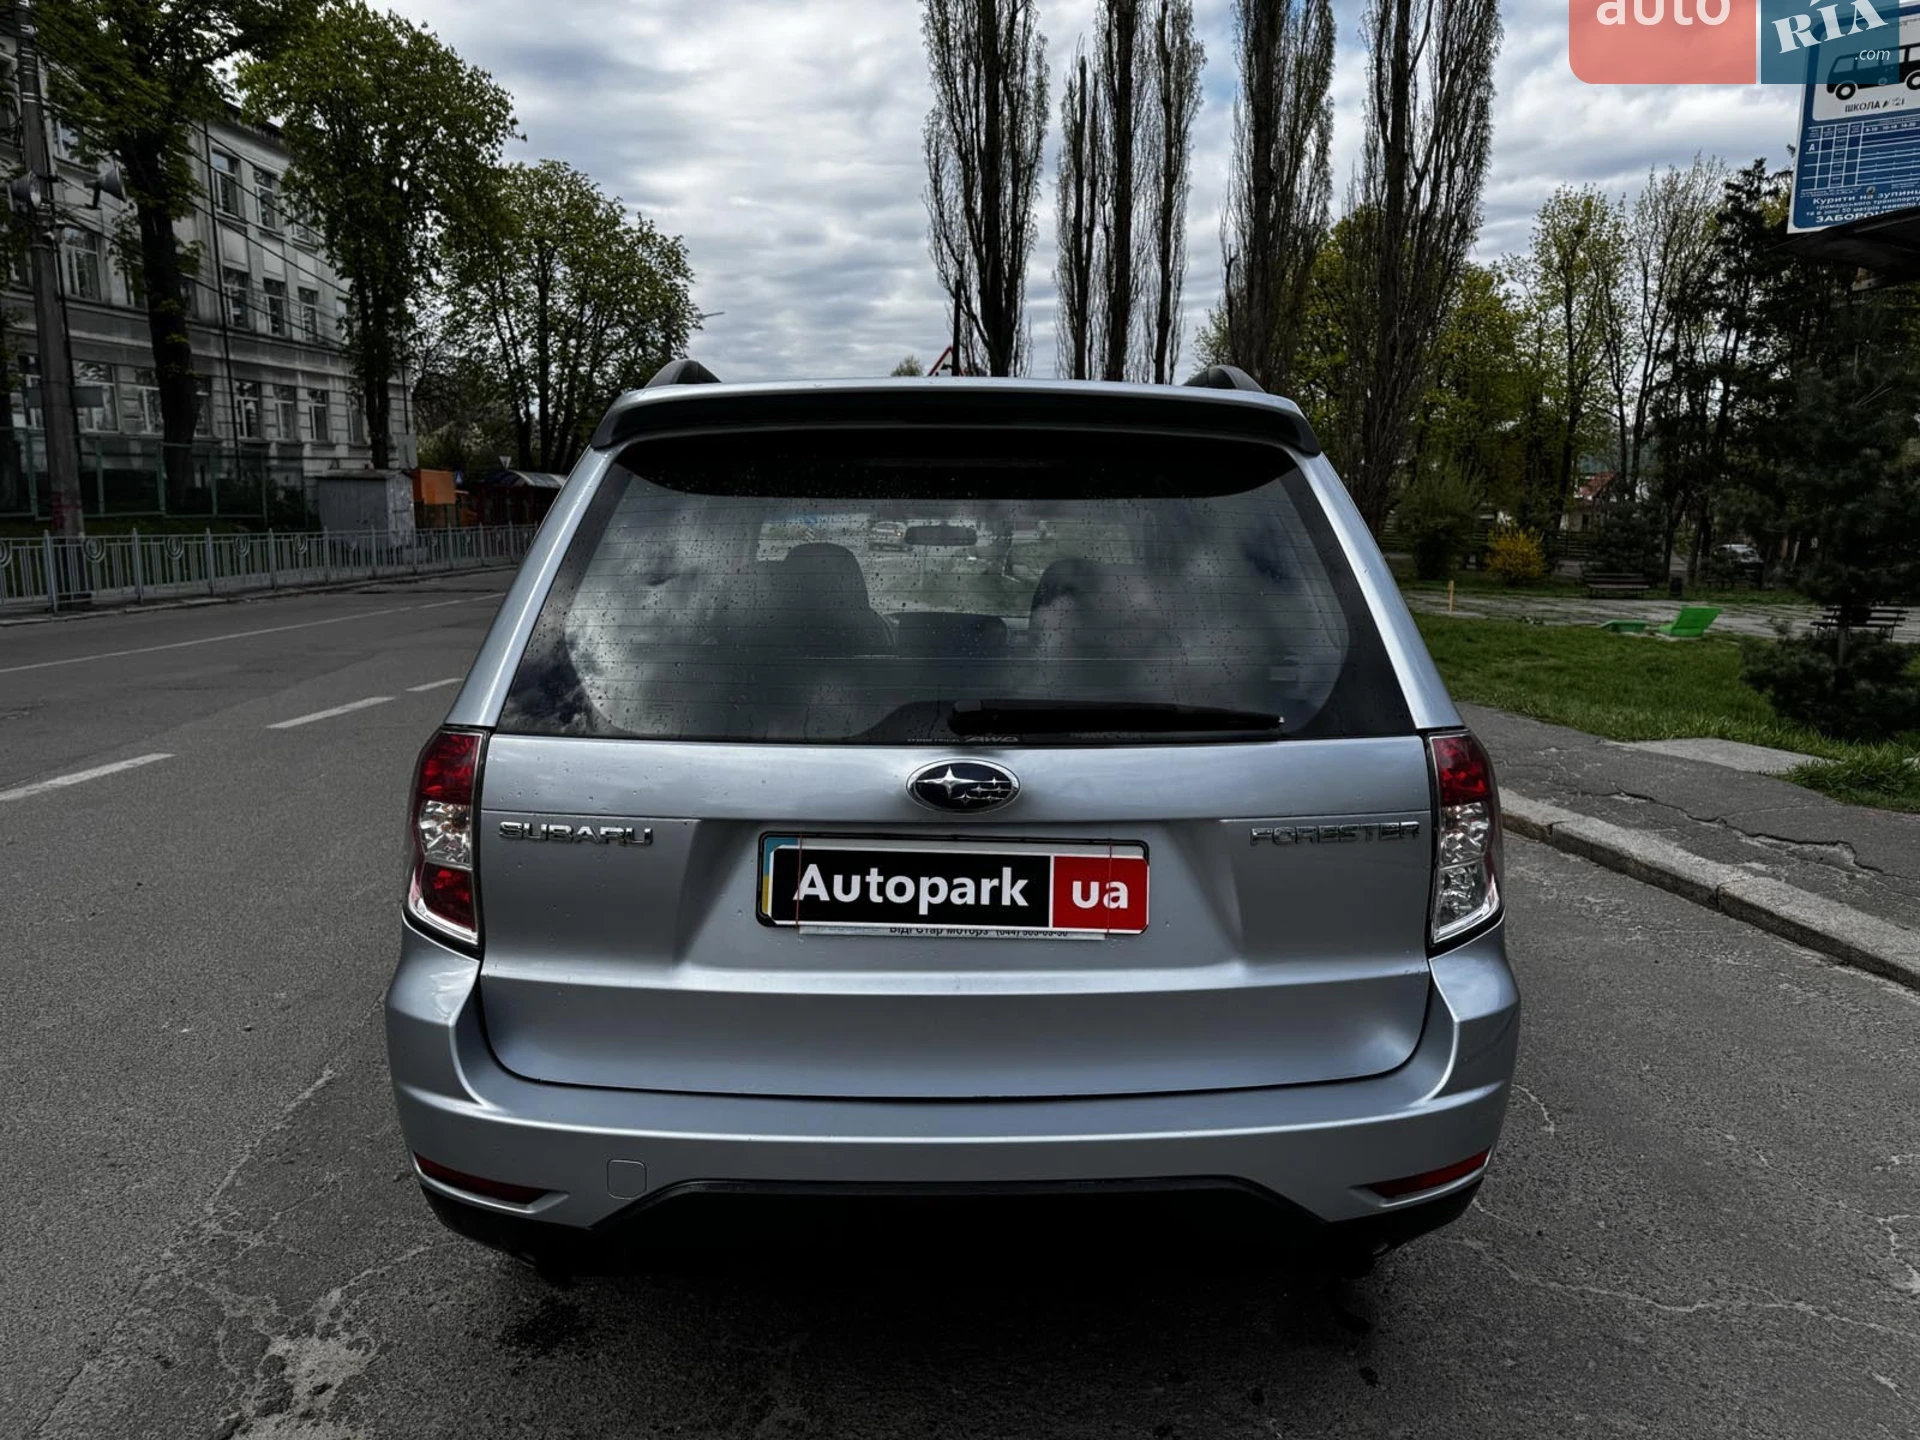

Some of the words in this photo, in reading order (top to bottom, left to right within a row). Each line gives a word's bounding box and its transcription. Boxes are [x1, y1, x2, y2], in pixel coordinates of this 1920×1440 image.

[1844, 100, 1881, 113] ШКОЛА
[1812, 195, 1856, 205] Курити
[964, 735, 1019, 743] AWD
[499, 821, 654, 846] SUBARU
[1251, 820, 1420, 846] FORESTER
[793, 863, 1029, 915] Autopark
[1071, 879, 1129, 909] ua
